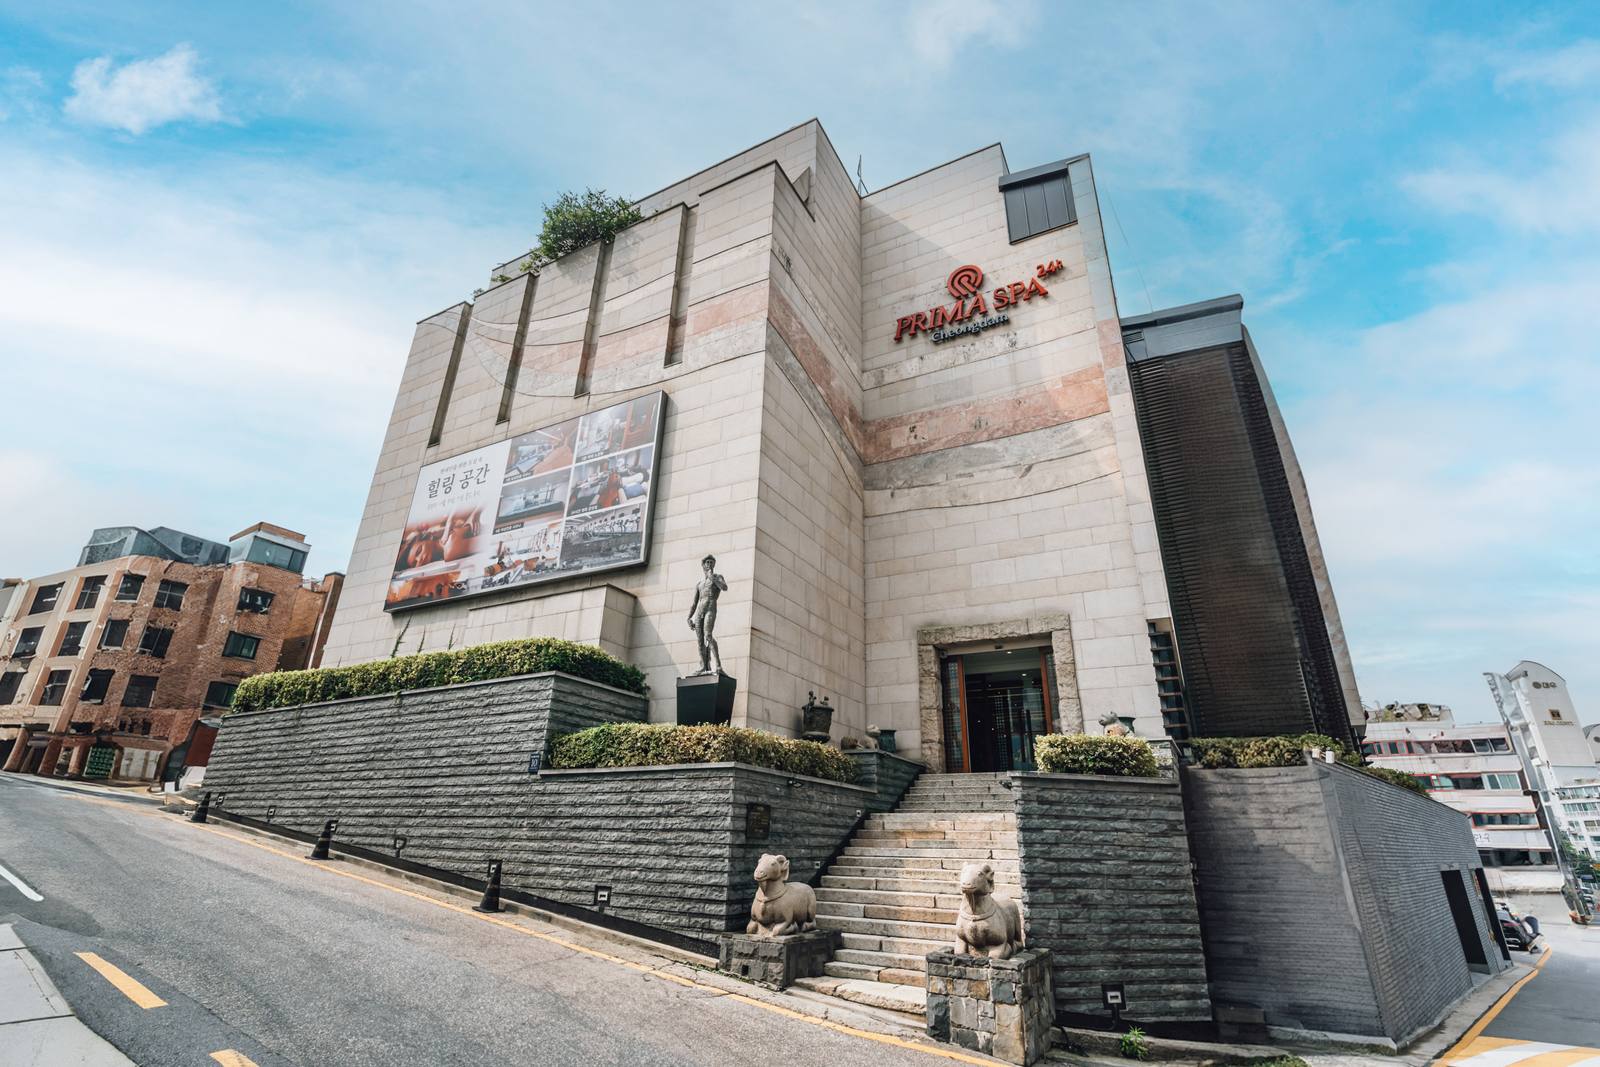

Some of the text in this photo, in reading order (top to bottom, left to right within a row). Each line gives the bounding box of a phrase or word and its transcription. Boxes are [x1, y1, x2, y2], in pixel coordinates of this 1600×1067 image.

[1036, 259, 1063, 277] 24h
[894, 277, 1049, 341] PRIMA SPA
[930, 313, 1009, 343] Cheongdam
[428, 473, 455, 499] 힐링
[459, 463, 490, 490] 공간
